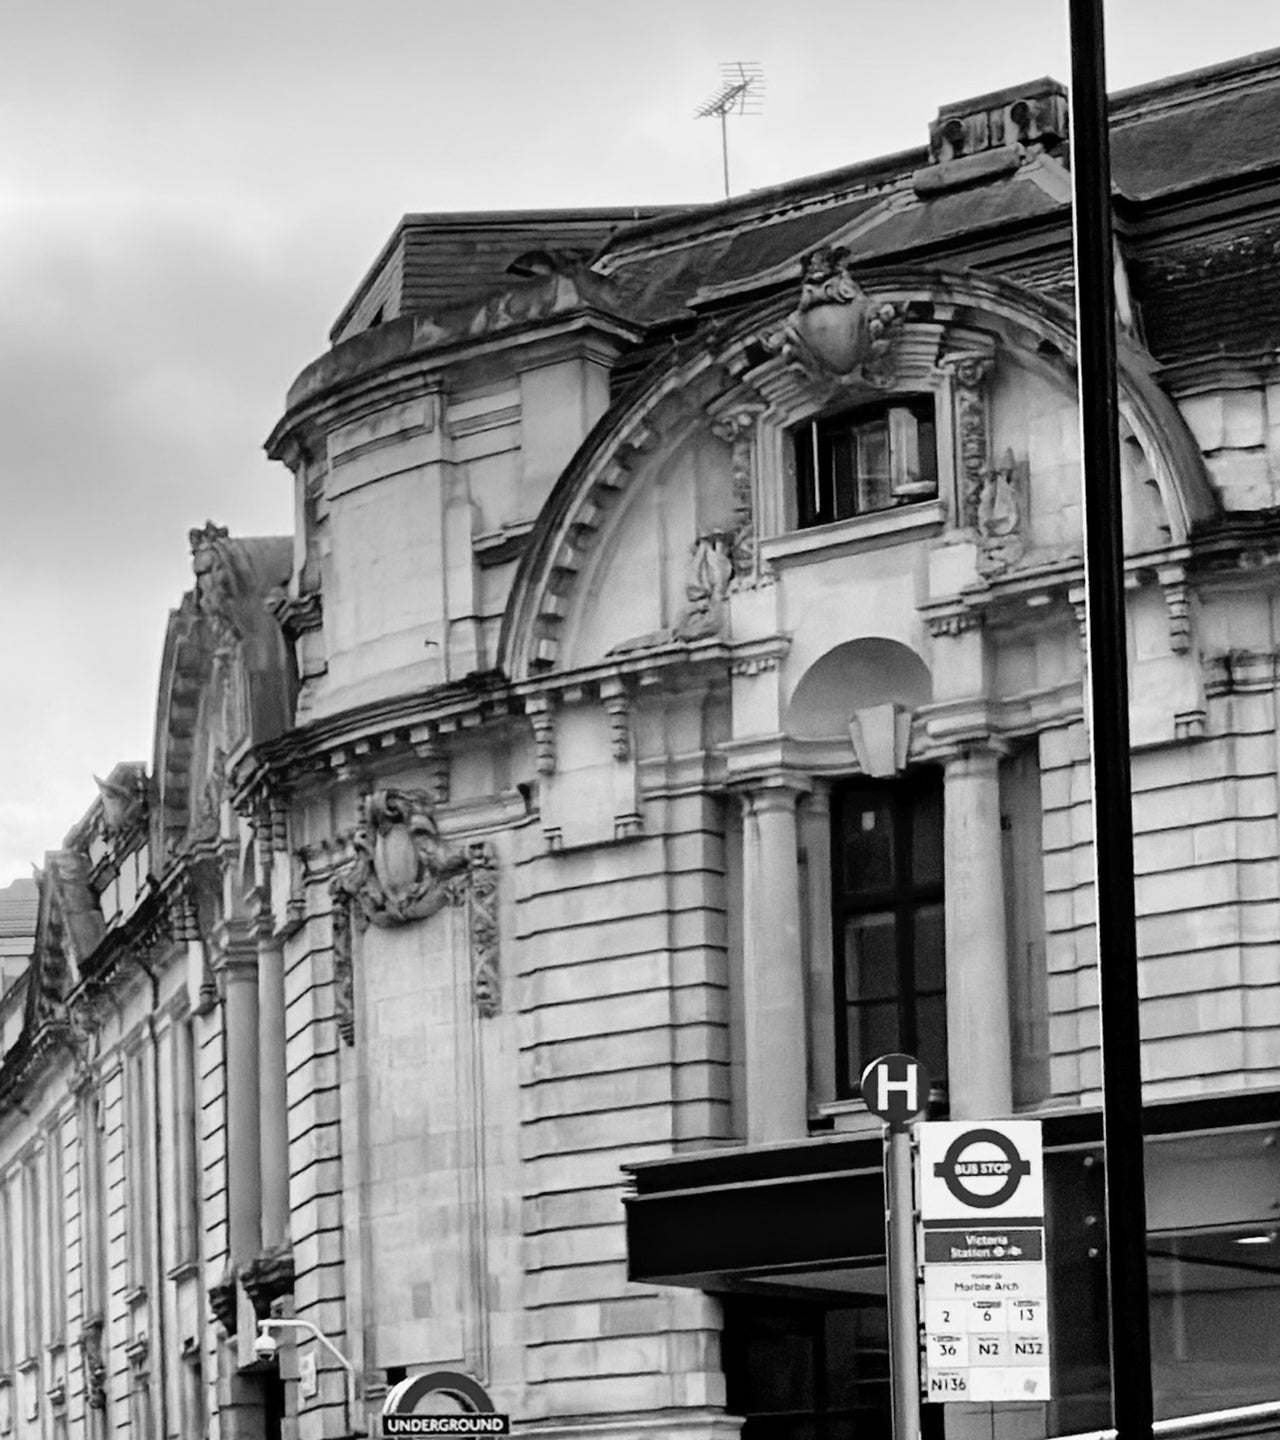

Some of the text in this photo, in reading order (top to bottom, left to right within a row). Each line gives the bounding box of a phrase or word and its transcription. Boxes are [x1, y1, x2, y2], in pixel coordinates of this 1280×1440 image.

[877, 1063, 918, 1112] H
[954, 1162, 1012, 1175] BUS STOP
[954, 1281, 1019, 1292] Marble Arch
[942, 1308, 1034, 1323] 2 6 13
[940, 1343, 1043, 1356] 36 N2 N32
[931, 1378, 967, 1391] N136
[387, 1417, 504, 1432] UNDERGROUND
